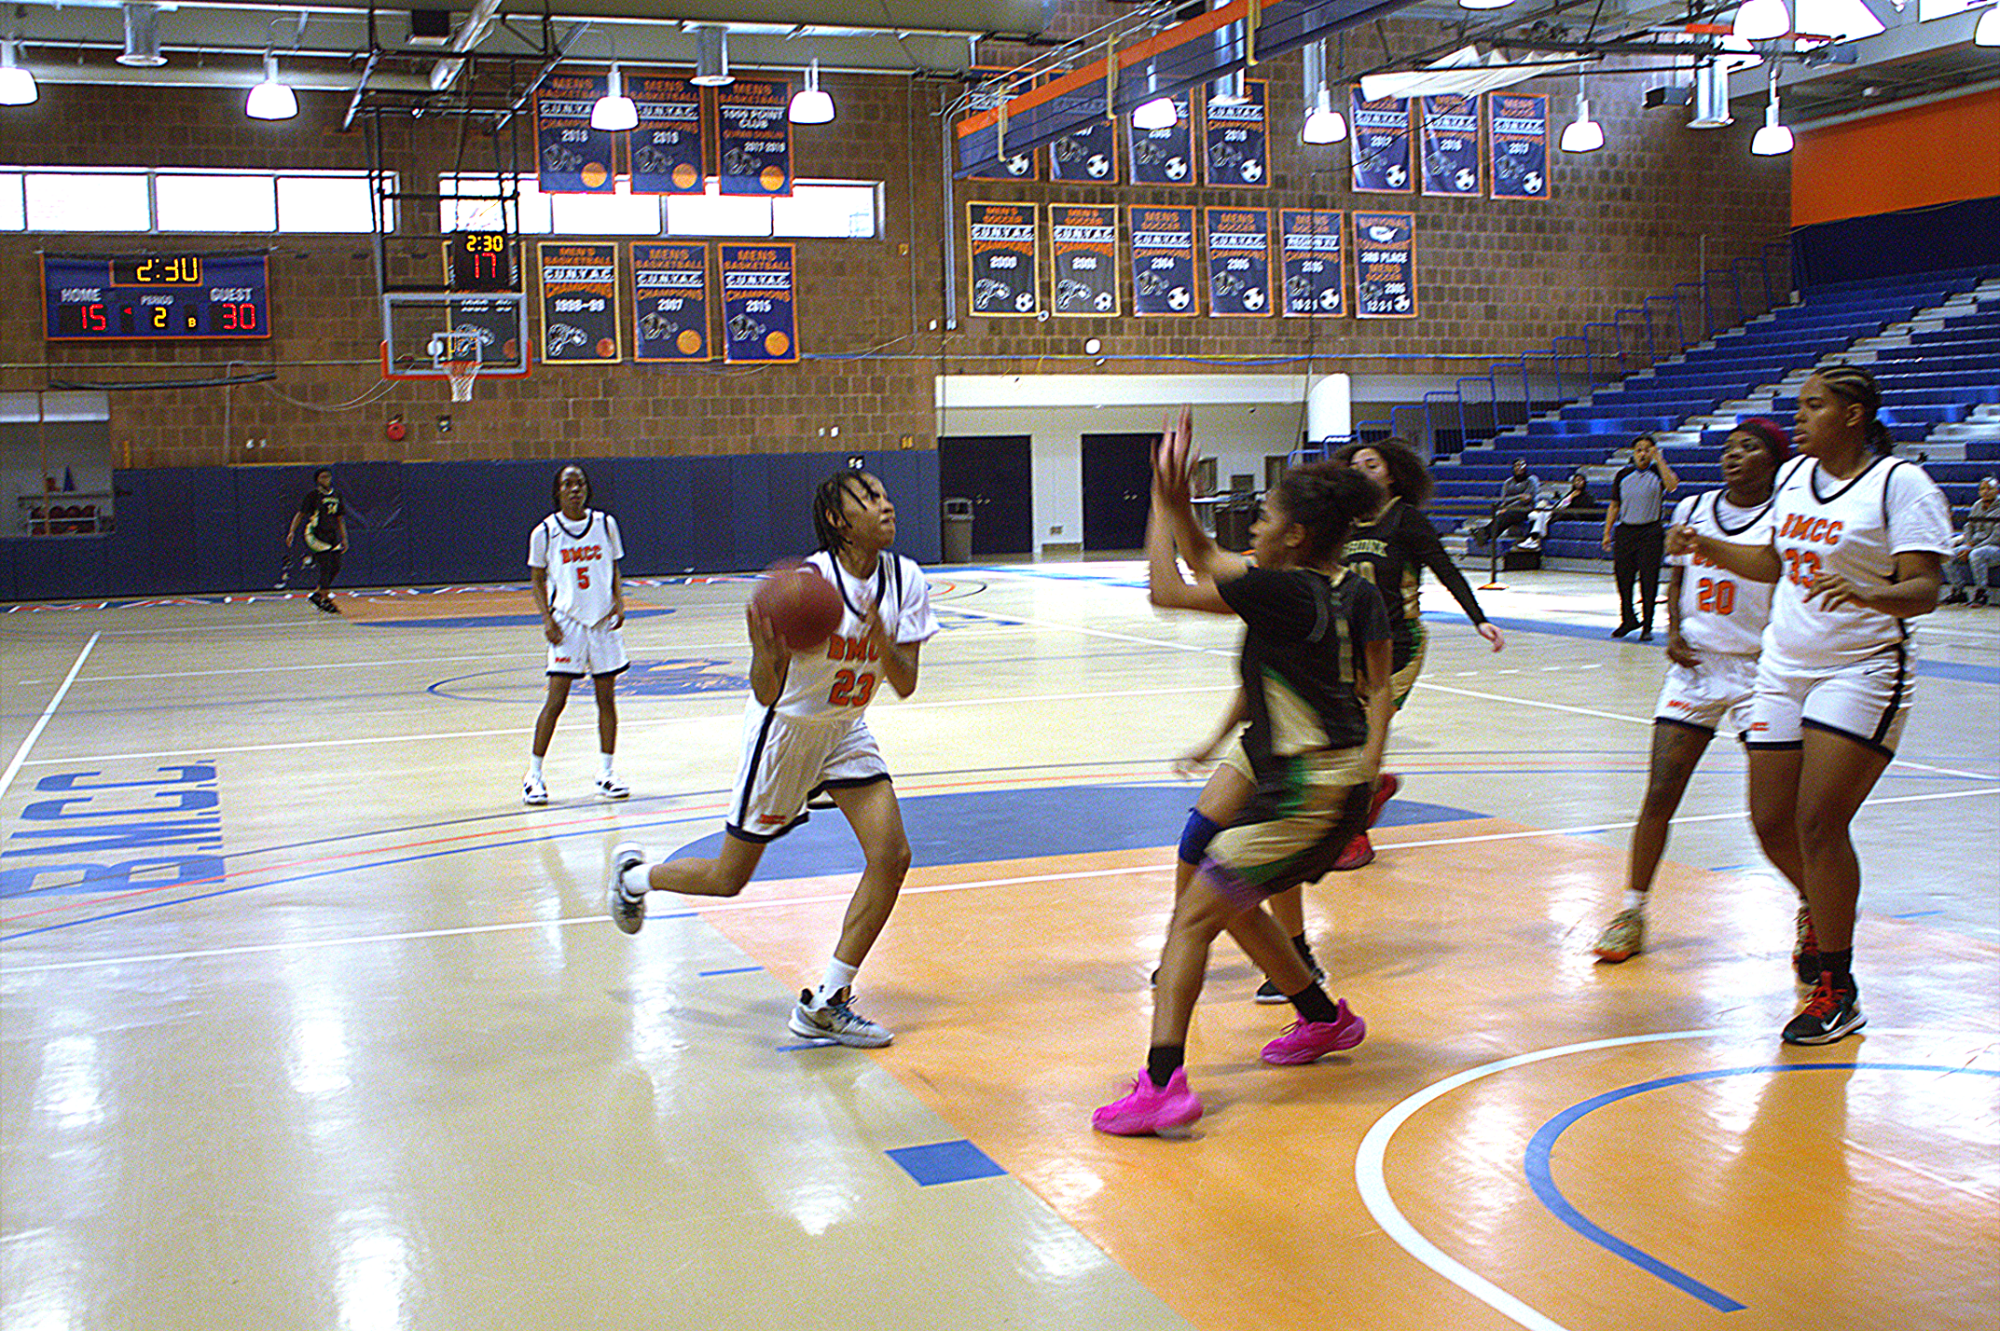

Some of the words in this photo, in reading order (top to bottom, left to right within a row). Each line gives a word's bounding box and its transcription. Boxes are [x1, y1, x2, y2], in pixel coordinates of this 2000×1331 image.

[540, 104, 592, 114] C.U.N.Y.A
[750, 109, 784, 120] POINT
[540, 119, 590, 131] CHAMPIO
[738, 119, 769, 130] CLUB
[466, 235, 503, 252] 2:30
[137, 257, 198, 282] 2:30
[475, 252, 496, 279] 17
[61, 288, 102, 303] HOME
[210, 287, 253, 302] GUEST
[545, 282, 613, 299] CHAMPIONS
[637, 289, 704, 301] CHAMPIONS
[726, 290, 791, 303] CHAMPIONS
[81, 303, 107, 331] 15
[154, 306, 167, 328] 2
[222, 303, 256, 330] 30
[560, 544, 602, 564] BMCC
[576, 565, 590, 590] 5
[1784, 547, 1822, 589] 33
[1697, 576, 1736, 616] 20
[827, 668, 876, 707] 23
[0, 757, 226, 900] BMCC
